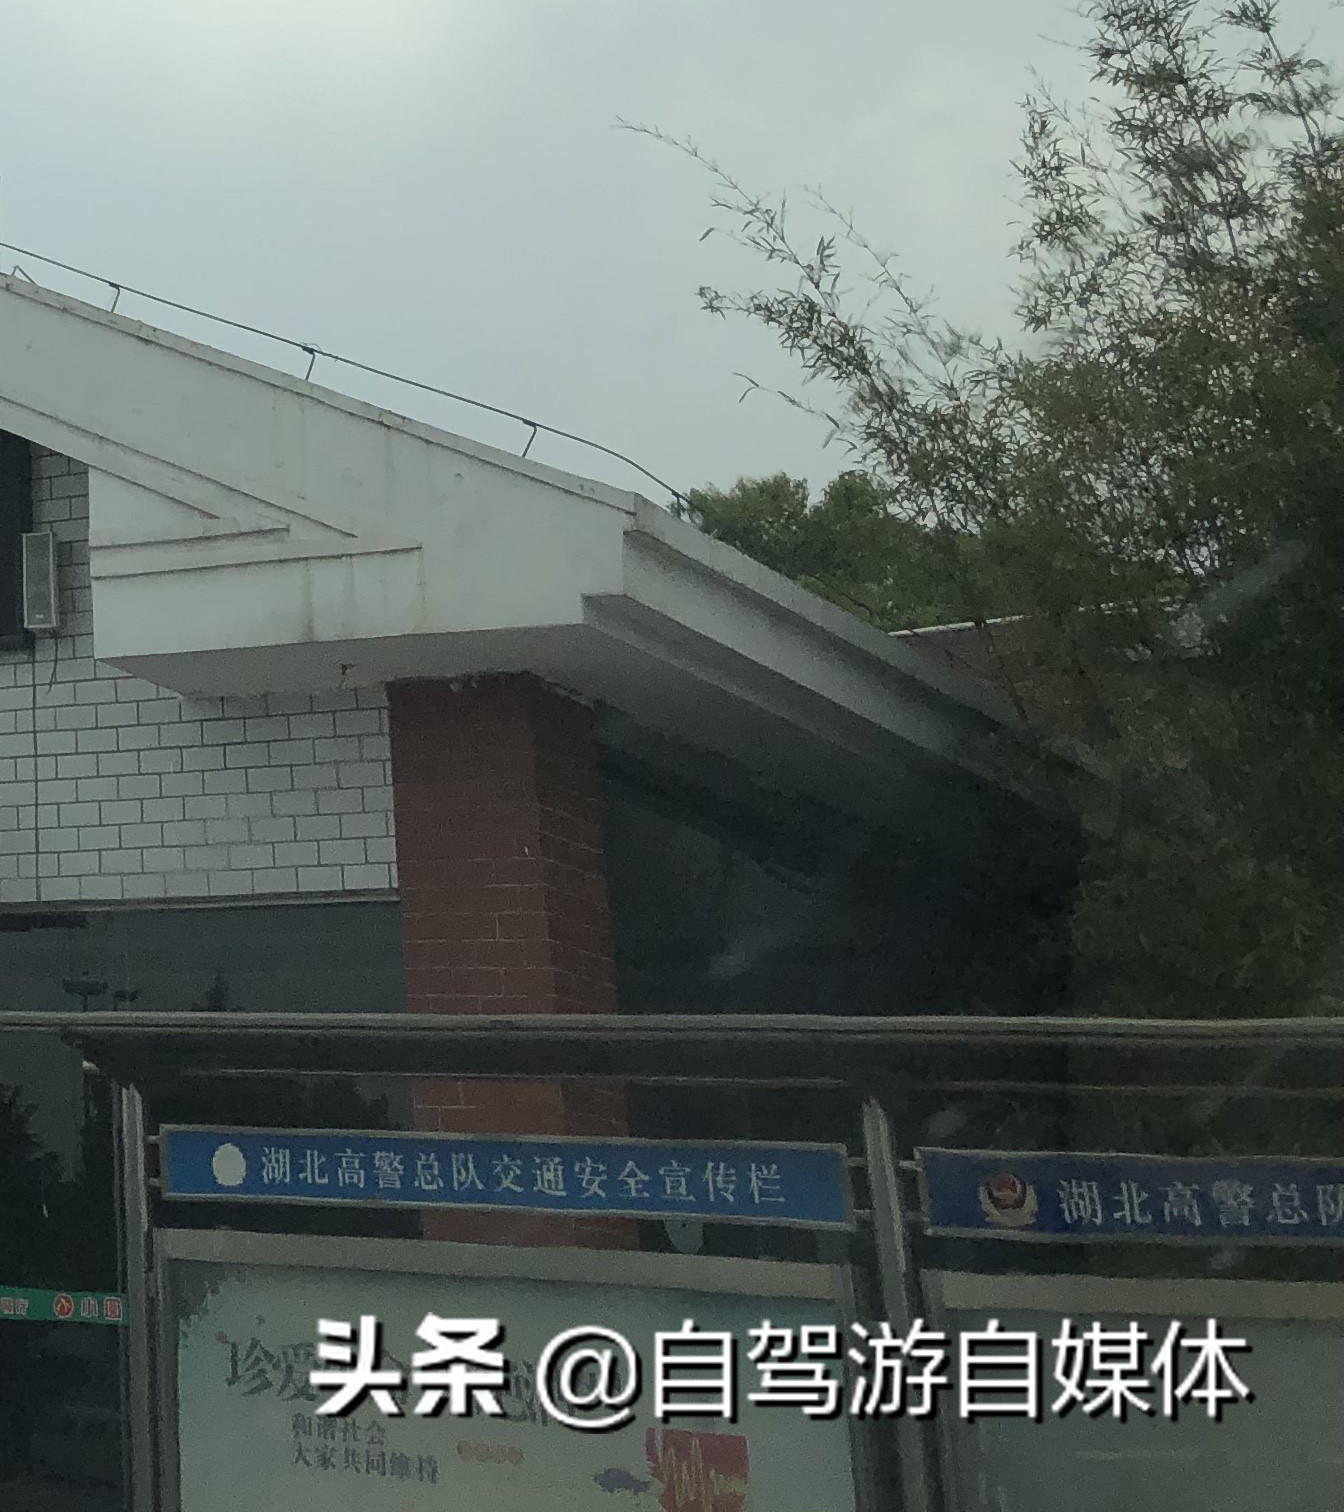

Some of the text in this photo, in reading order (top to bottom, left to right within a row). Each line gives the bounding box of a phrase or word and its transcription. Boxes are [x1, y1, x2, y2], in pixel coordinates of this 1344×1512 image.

[261, 1144, 788, 1206] 湖北高警总队交通安全宣传栏
